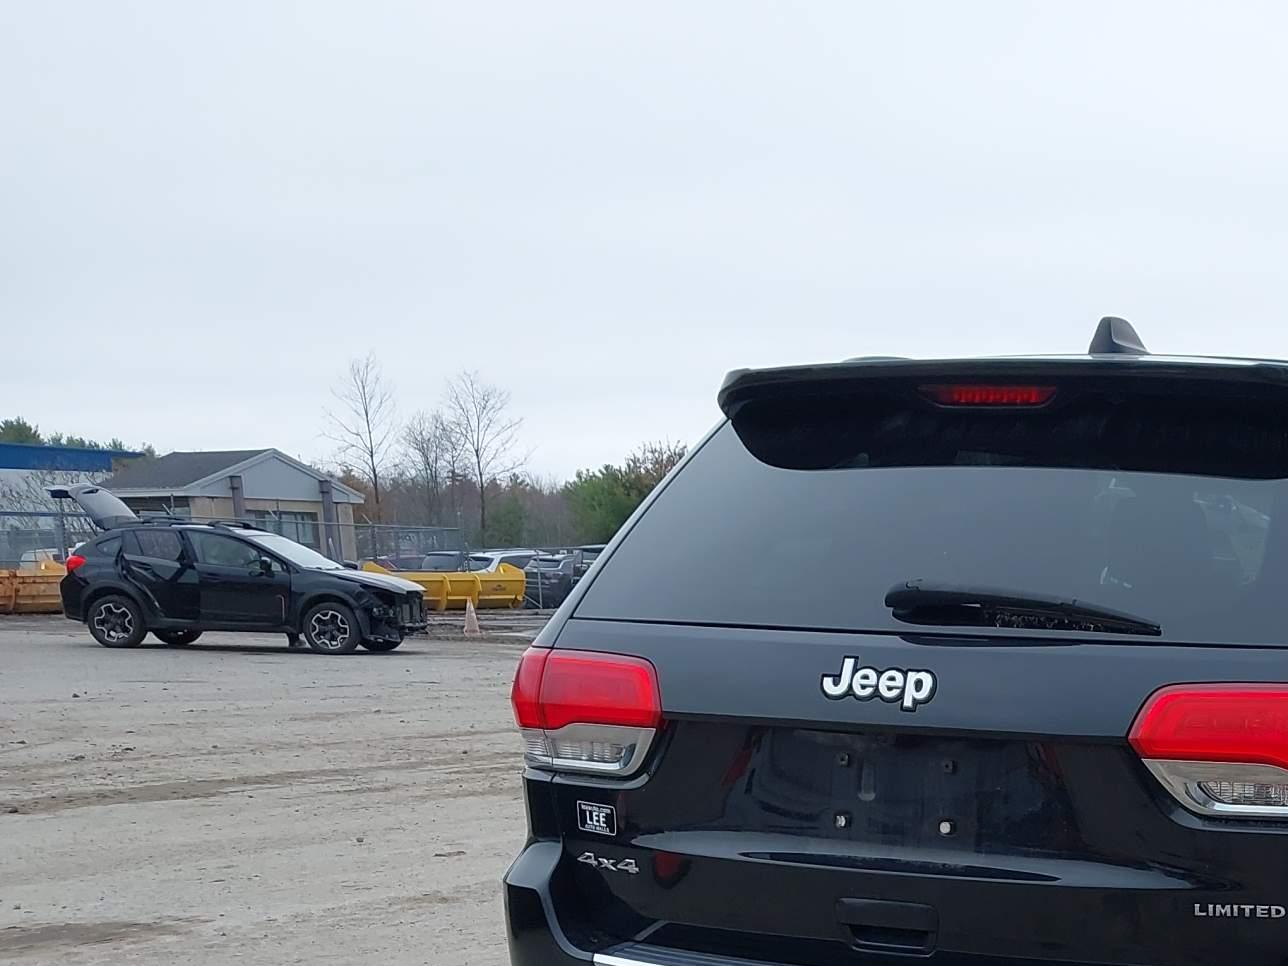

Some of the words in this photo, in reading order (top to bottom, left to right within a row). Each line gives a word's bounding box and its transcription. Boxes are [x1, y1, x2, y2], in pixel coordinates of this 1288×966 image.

[822, 656, 935, 710] Jeep
[586, 810, 607, 827] LEE
[577, 852, 640, 874] 4x4
[1194, 903, 1286, 918] LIMITED
